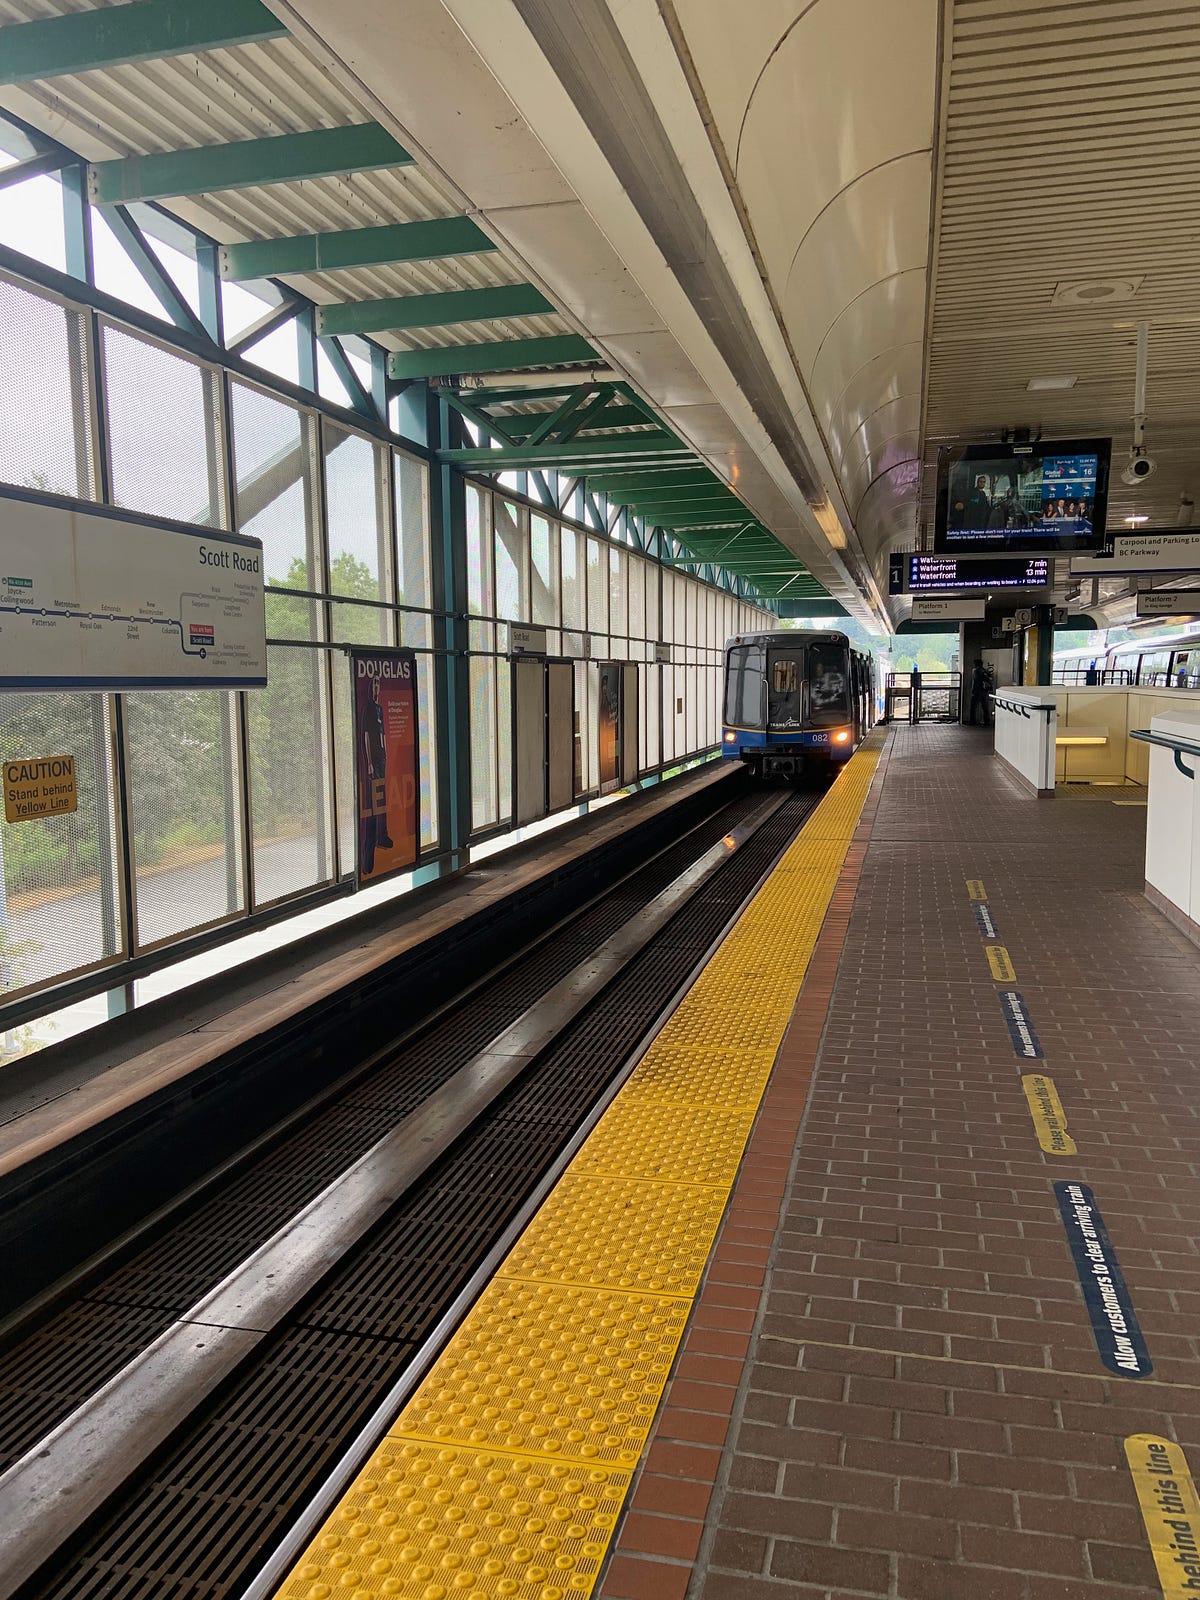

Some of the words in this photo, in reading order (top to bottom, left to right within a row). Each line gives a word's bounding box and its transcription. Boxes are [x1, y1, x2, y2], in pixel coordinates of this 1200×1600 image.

[199, 546, 230, 568] Scott
[233, 552, 259, 573] Road
[920, 564, 956, 572] Waterfront
[1034, 560, 1047, 568] min
[892, 570, 900, 583] 1
[920, 572, 956, 580] Waterfront
[1034, 568, 1047, 576] min
[0, 594, 34, 605] Collingwood
[54, 600, 80, 608] Metrotown
[101, 604, 122, 612] Edmonds
[32, 618, 56, 628] Patterson
[80, 622, 92, 630] Royal
[358, 660, 410, 679] DOUGLAS
[812, 734, 828, 742] 082
[8, 760, 72, 783] CAUTION
[9, 787, 38, 801] Stand
[43, 782, 72, 796] behind
[16, 802, 46, 815] Yellow
[50, 798, 69, 809] Line
[1023, 1044, 1036, 1057] Allow
[1032, 1078, 1046, 1086] line
[1034, 1087, 1048, 1098] this
[1038, 1098, 1055, 1116] behind
[1044, 1118, 1060, 1130] wait
[1052, 1131, 1066, 1152] Please
[1065, 1185, 1086, 1204] train
[1072, 1205, 1097, 1239] arriving
[1085, 1240, 1105, 1262] clear
[1092, 1264, 1110, 1275] to
[1096, 1276, 1128, 1334] customers
[1113, 1336, 1140, 1372] Allow
[1146, 1444, 1173, 1475] line
[1153, 1480, 1186, 1514] this
[1163, 1520, 1200, 1590] behind
